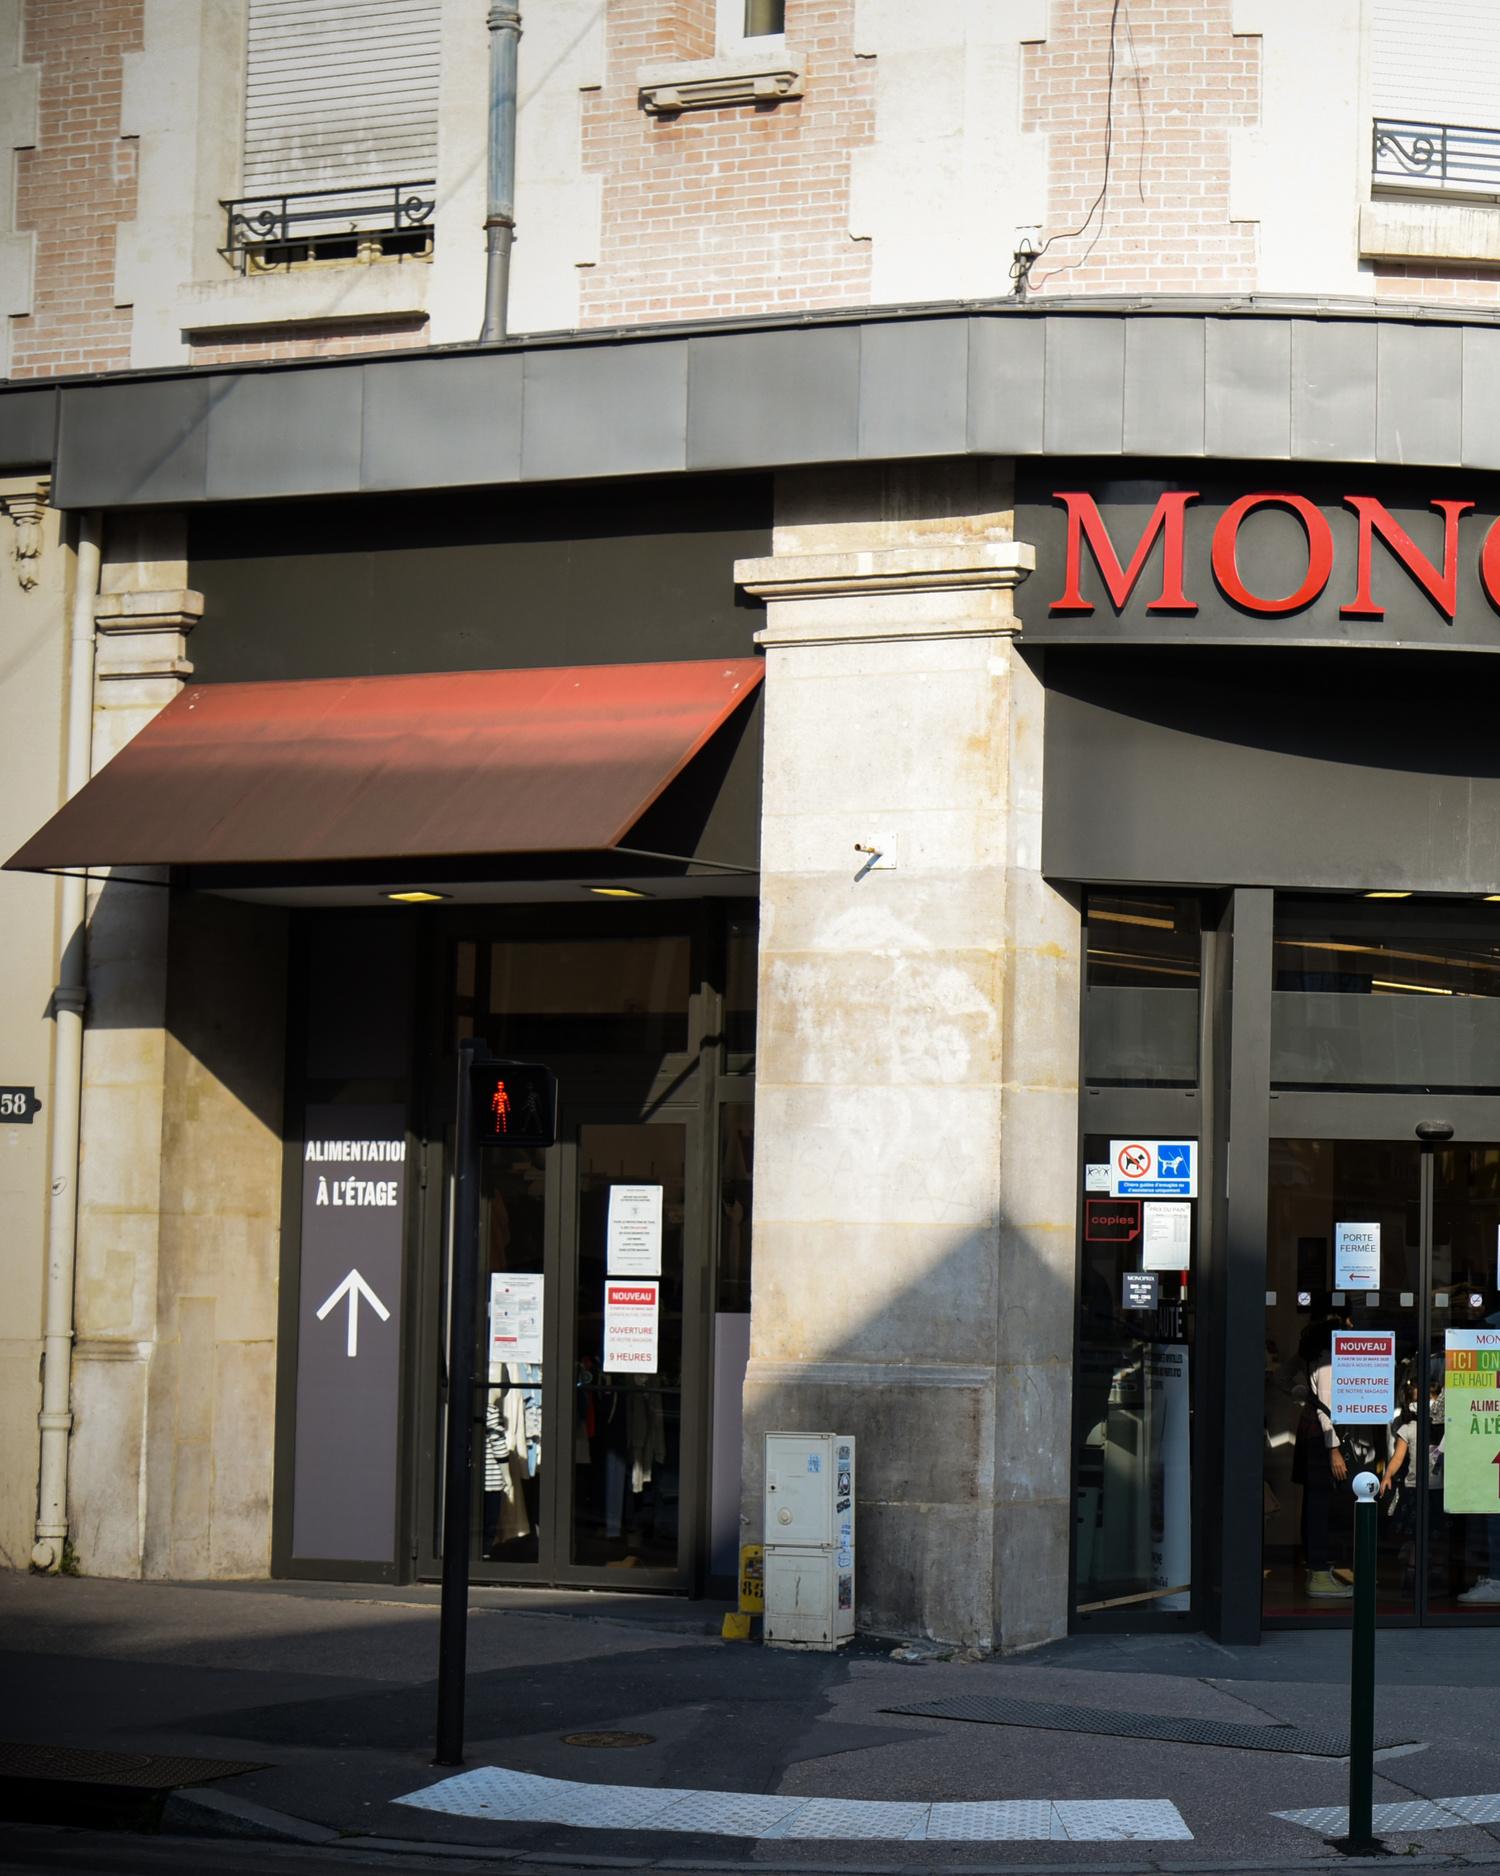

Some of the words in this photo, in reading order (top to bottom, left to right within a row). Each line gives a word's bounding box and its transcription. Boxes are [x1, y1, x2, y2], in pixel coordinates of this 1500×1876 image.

[0, 1093, 26, 1115] 58
[316, 1176, 329, 1206] À
[333, 1176, 398, 1206] L'ÉTAGE
[1091, 1215, 1135, 1226] copies
[1343, 1233, 1373, 1241] PORTE
[1340, 1243, 1376, 1253] FERMÉE
[612, 1292, 652, 1301] NOUVEAU
[609, 1326, 654, 1335] OUVERTURE
[1340, 1342, 1387, 1351] NOUVEAU
[609, 1352, 615, 1361] 9
[616, 1352, 652, 1361] HEURES
[1453, 1352, 1472, 1369] ICI
[1481, 1352, 1499, 1369] ON
[1336, 1378, 1389, 1386] OUVERTURE
[1453, 1372, 1464, 1387] EN
[1468, 1372, 1493, 1387] HAUT
[1337, 1405, 1343, 1413] 9
[1345, 1405, 1388, 1413] HEURES
[1470, 1414, 1480, 1434] À
